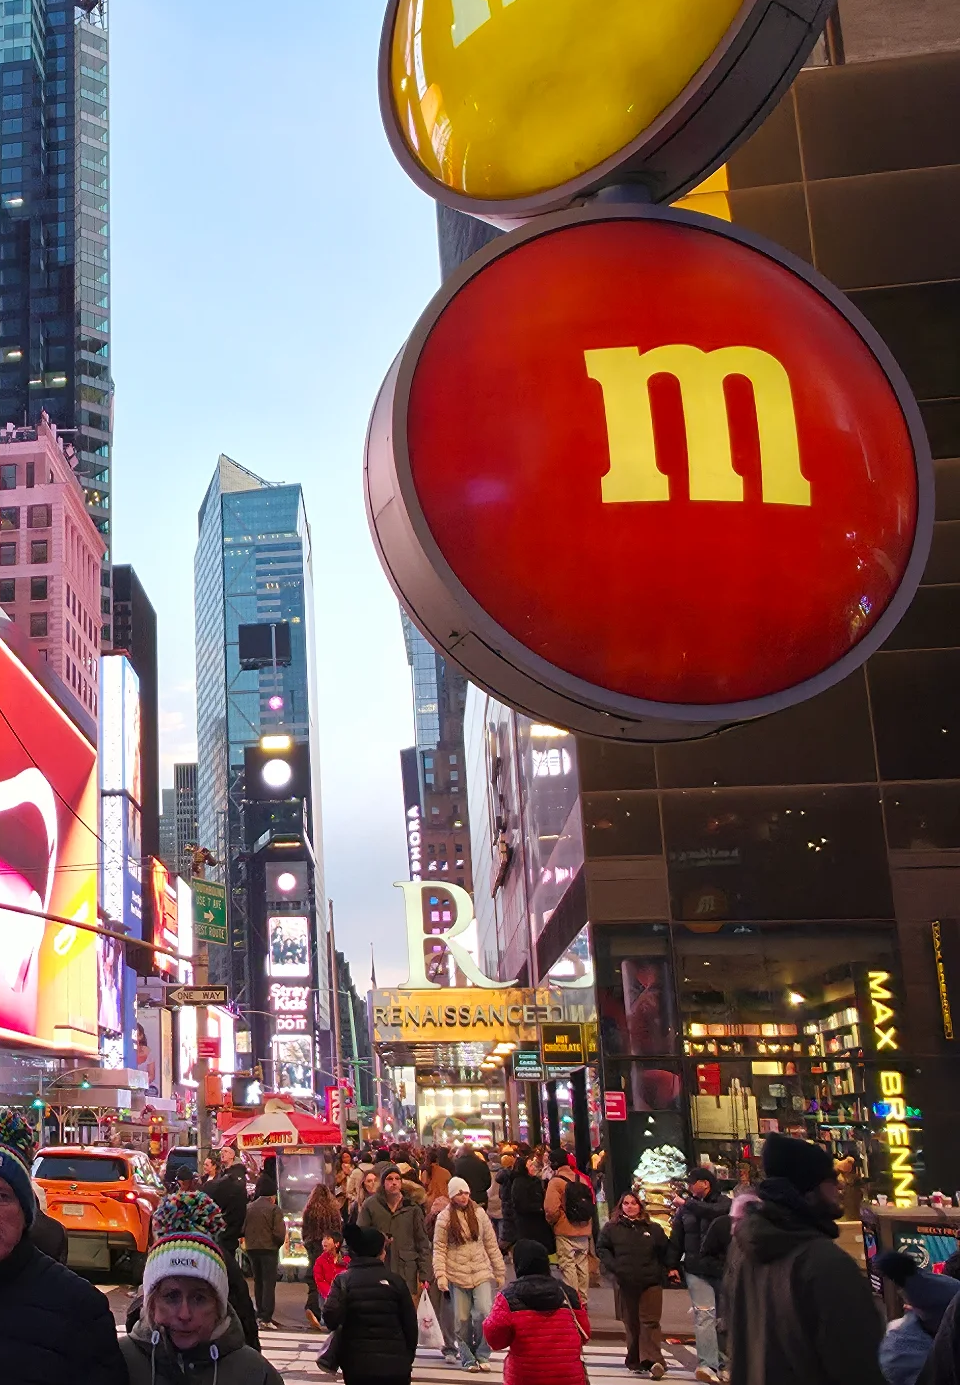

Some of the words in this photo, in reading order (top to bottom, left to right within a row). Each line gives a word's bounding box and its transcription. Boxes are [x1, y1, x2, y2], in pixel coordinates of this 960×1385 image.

[586, 343, 812, 505] m
[407, 804, 423, 881] EPHORA
[195, 925, 207, 936] BEST
[209, 927, 225, 939] ROUTE
[393, 880, 519, 990] R
[177, 992, 194, 1000] ONE
[202, 991, 221, 999] WAY
[270, 983, 310, 998] Stray
[274, 996, 308, 1011] Kids
[868, 971, 898, 1051] MAX
[277, 1018, 295, 1030] DO
[296, 1018, 307, 1030] IT
[373, 1004, 537, 1028] RENAISSANCE
[880, 1070, 919, 1209] BRENN
